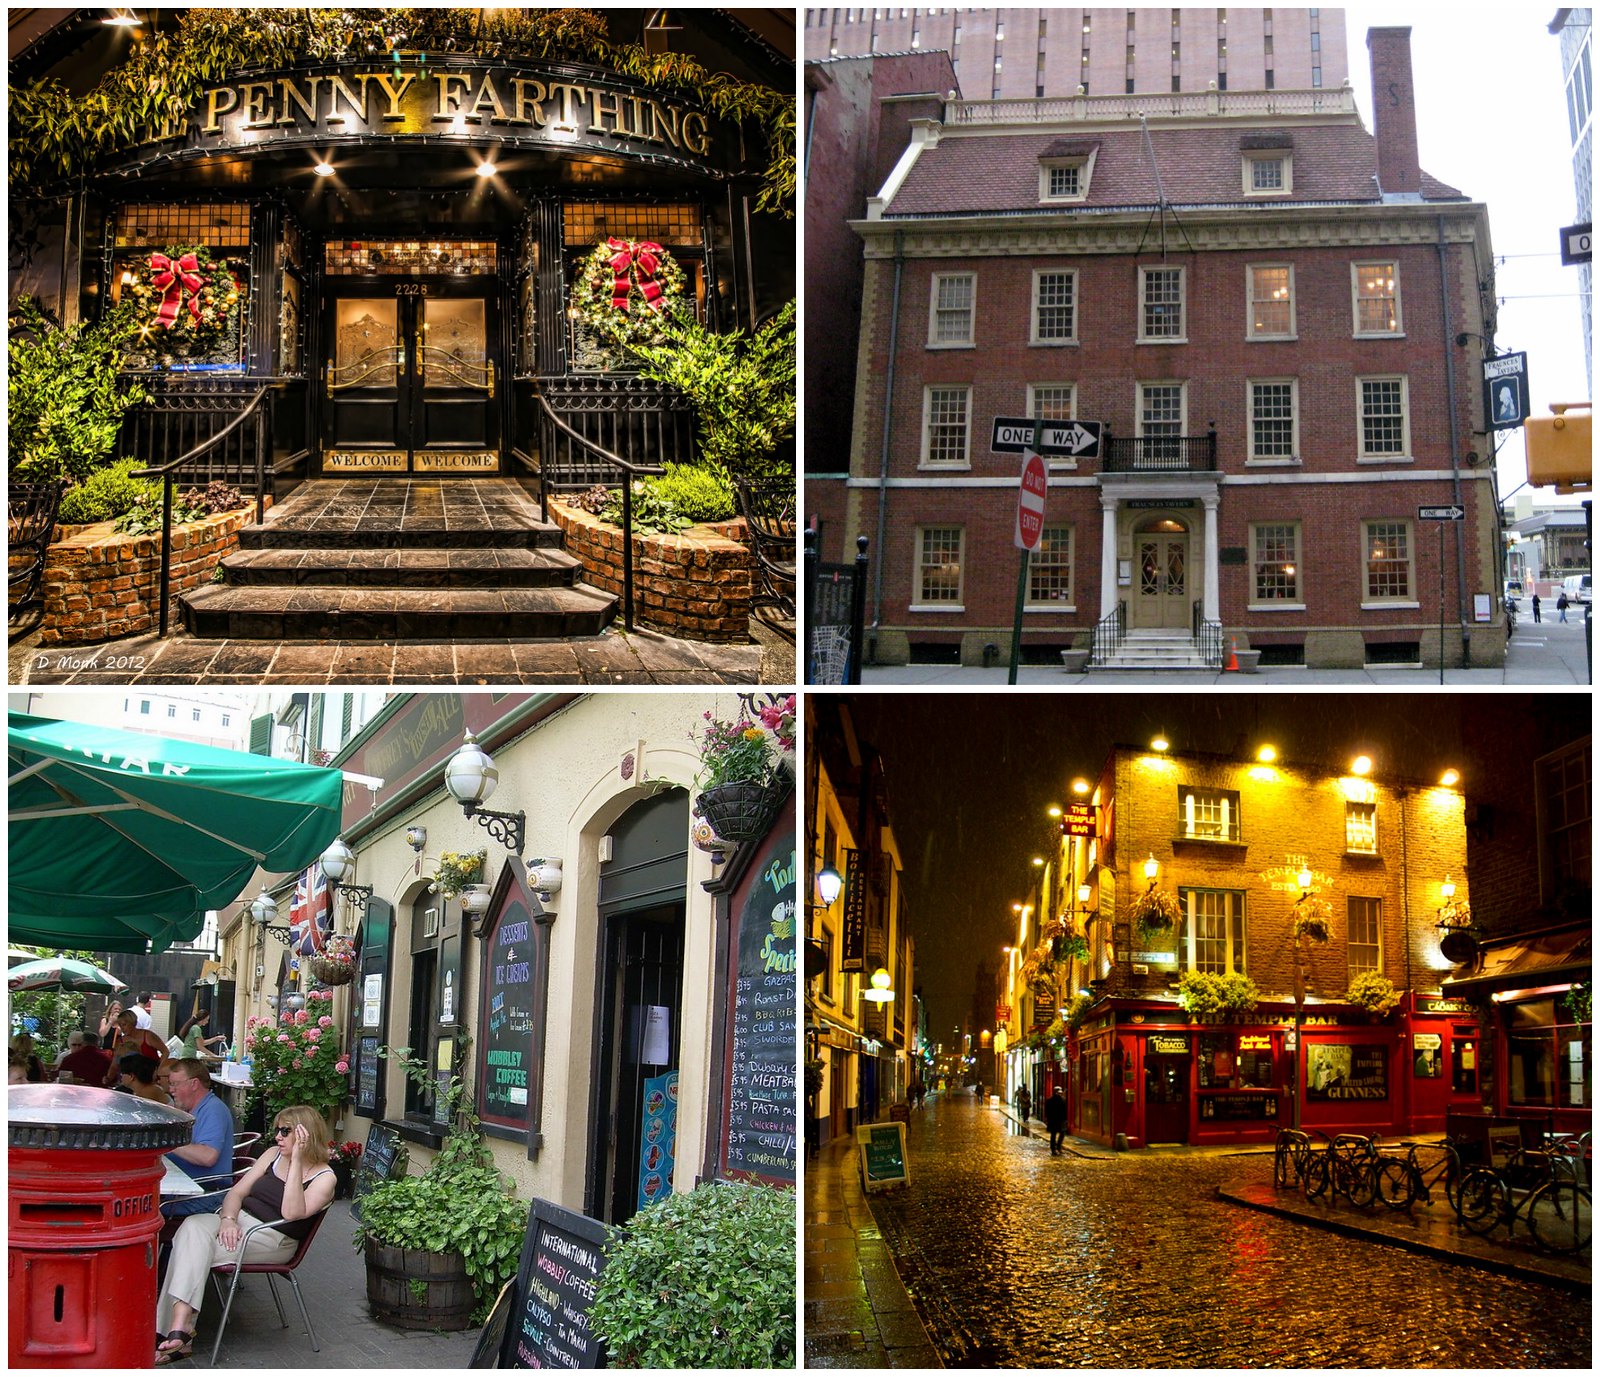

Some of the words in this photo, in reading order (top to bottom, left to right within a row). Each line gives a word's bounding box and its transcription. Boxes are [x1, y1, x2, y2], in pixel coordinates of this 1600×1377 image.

[200, 73, 417, 135] PENNY
[430, 72, 714, 157] FARTHING
[395, 284, 428, 295] 2228
[1488, 357, 1519, 371] FRAUNCES
[1497, 365, 1520, 377] TAVERN
[1002, 428, 1033, 443] ONE
[1053, 431, 1084, 446] WAY
[331, 455, 402, 467] WELCOME
[421, 454, 493, 467] WELCOME
[1026, 471, 1034, 486] DO
[1034, 475, 1045, 493] NOT
[1022, 513, 1039, 531] ENTER
[1071, 806, 1088, 815] THE
[1063, 814, 1095, 824] TEMPLE
[1071, 824, 1088, 833] BAR
[1285, 854, 1309, 866] THE
[1311, 869, 1334, 887] BAR
[855, 872, 864, 937] RESTAURANT
[760, 933, 796, 974] Speci
[1189, 1013, 1226, 1025] THE
[1234, 1013, 1297, 1025] TEMPLE
[1305, 1014, 1339, 1026] BAR
[752, 1021, 775, 1033] CLUB
[1154, 1038, 1187, 1051] TOBACCO
[496, 1068, 528, 1087] COFFEE
[1327, 1086, 1386, 1099] GUINNESS
[752, 1101, 780, 1115] PASTA
[749, 1119, 778, 1131] CHICKEN
[746, 1152, 790, 1170] CUMBERLAND
[114, 1194, 153, 1217] OFFICE
[540, 1229, 597, 1274] INTERNATIONAL
[564, 1269, 597, 1302] COFFEE
[526, 1299, 552, 1327] CALYPSO
[545, 1337, 580, 1369] COINTREAU
